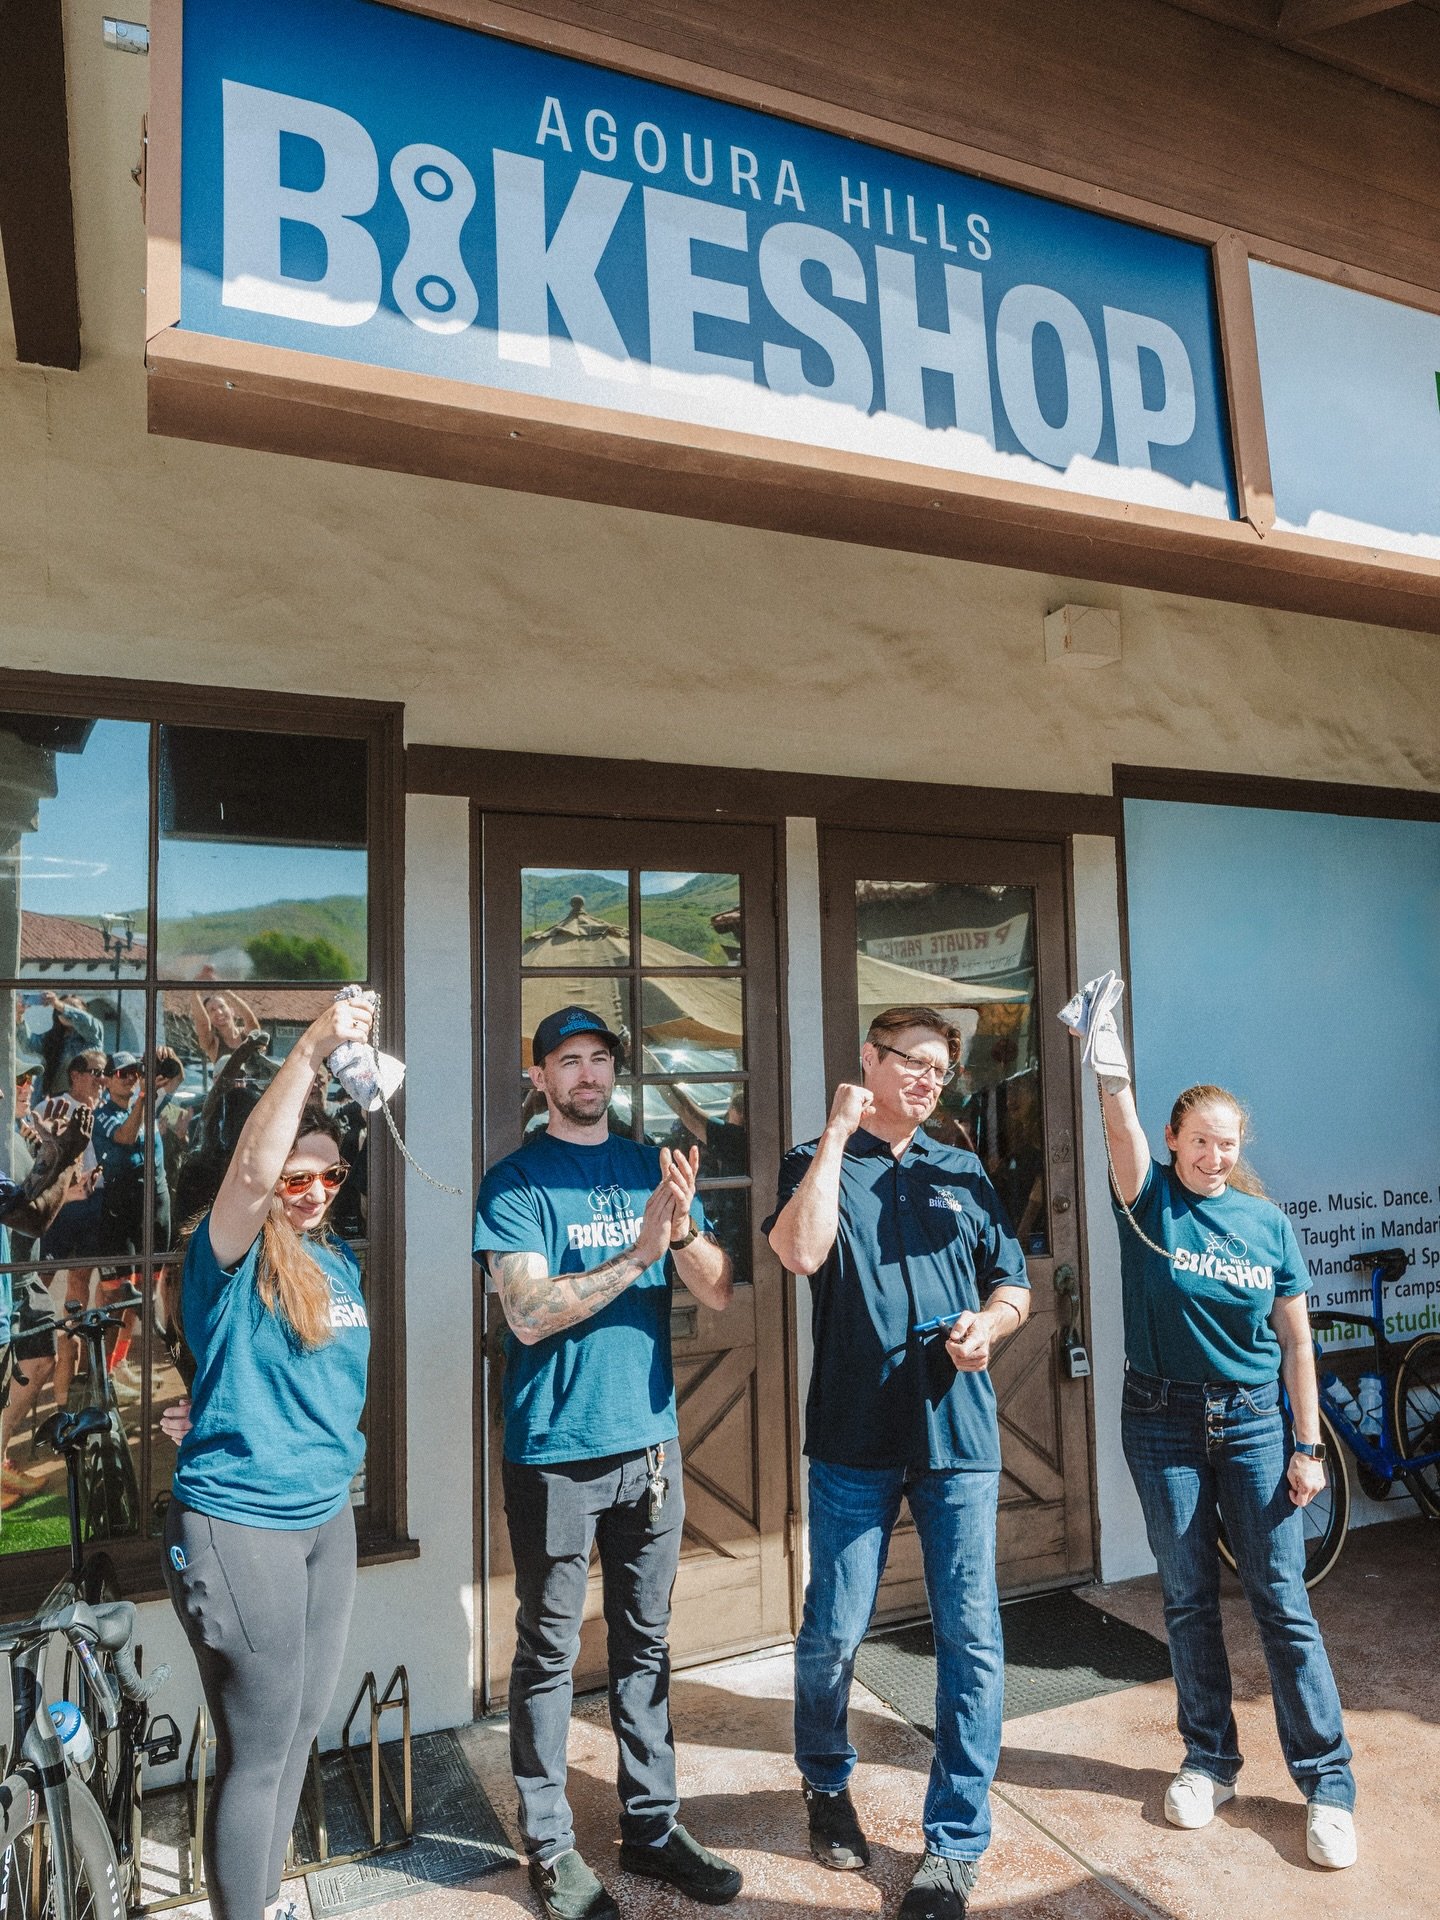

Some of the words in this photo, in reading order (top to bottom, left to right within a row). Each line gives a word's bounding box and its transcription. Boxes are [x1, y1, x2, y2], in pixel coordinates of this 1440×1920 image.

[536, 96, 806, 212] AGOURA
[840, 175, 993, 261] HILLS
[221, 78, 1197, 474] BIKESHOP
[1279, 1200, 1322, 1219] uage.
[1328, 1192, 1377, 1212] Music.
[1383, 1190, 1433, 1207] Dance.
[1301, 1224, 1356, 1248] Taught
[1361, 1222, 1376, 1241] in
[1381, 1216, 1440, 1238] Mandari
[1327, 1286, 1389, 1306] summr
[1385, 1304, 1440, 1335] studi
